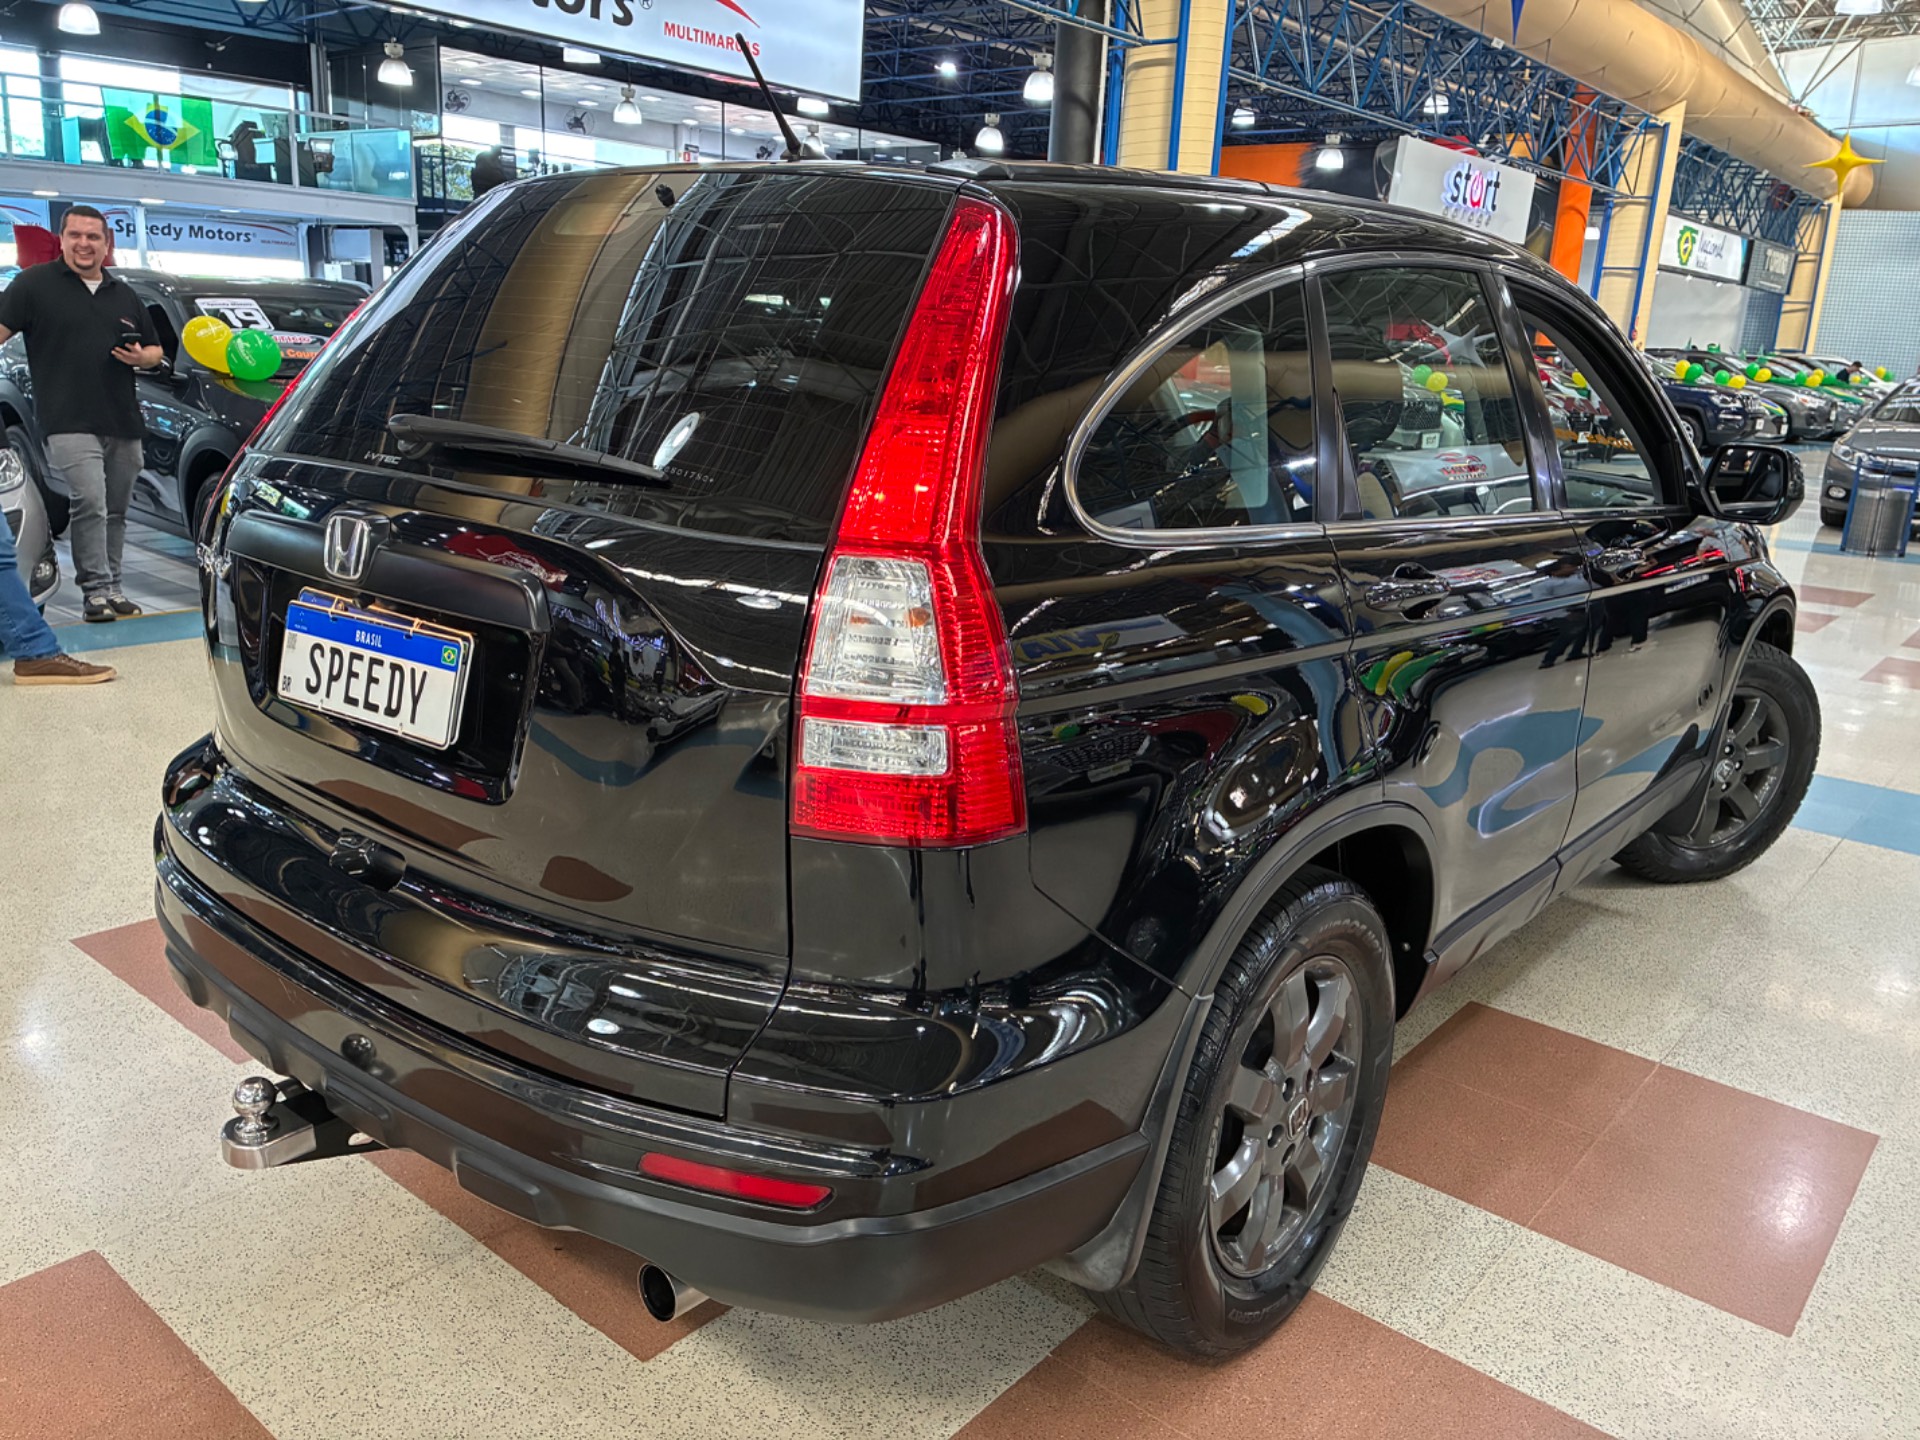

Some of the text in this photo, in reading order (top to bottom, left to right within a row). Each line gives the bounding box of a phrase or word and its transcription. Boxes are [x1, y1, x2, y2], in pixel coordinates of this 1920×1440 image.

[663, 21, 760, 56] MULTIMARCS
[188, 225, 252, 243] Motors
[219, 308, 270, 329] 19
[354, 629, 384, 649] BRASIL
[281, 674, 293, 693] BR
[305, 642, 429, 725] SPEEDY
